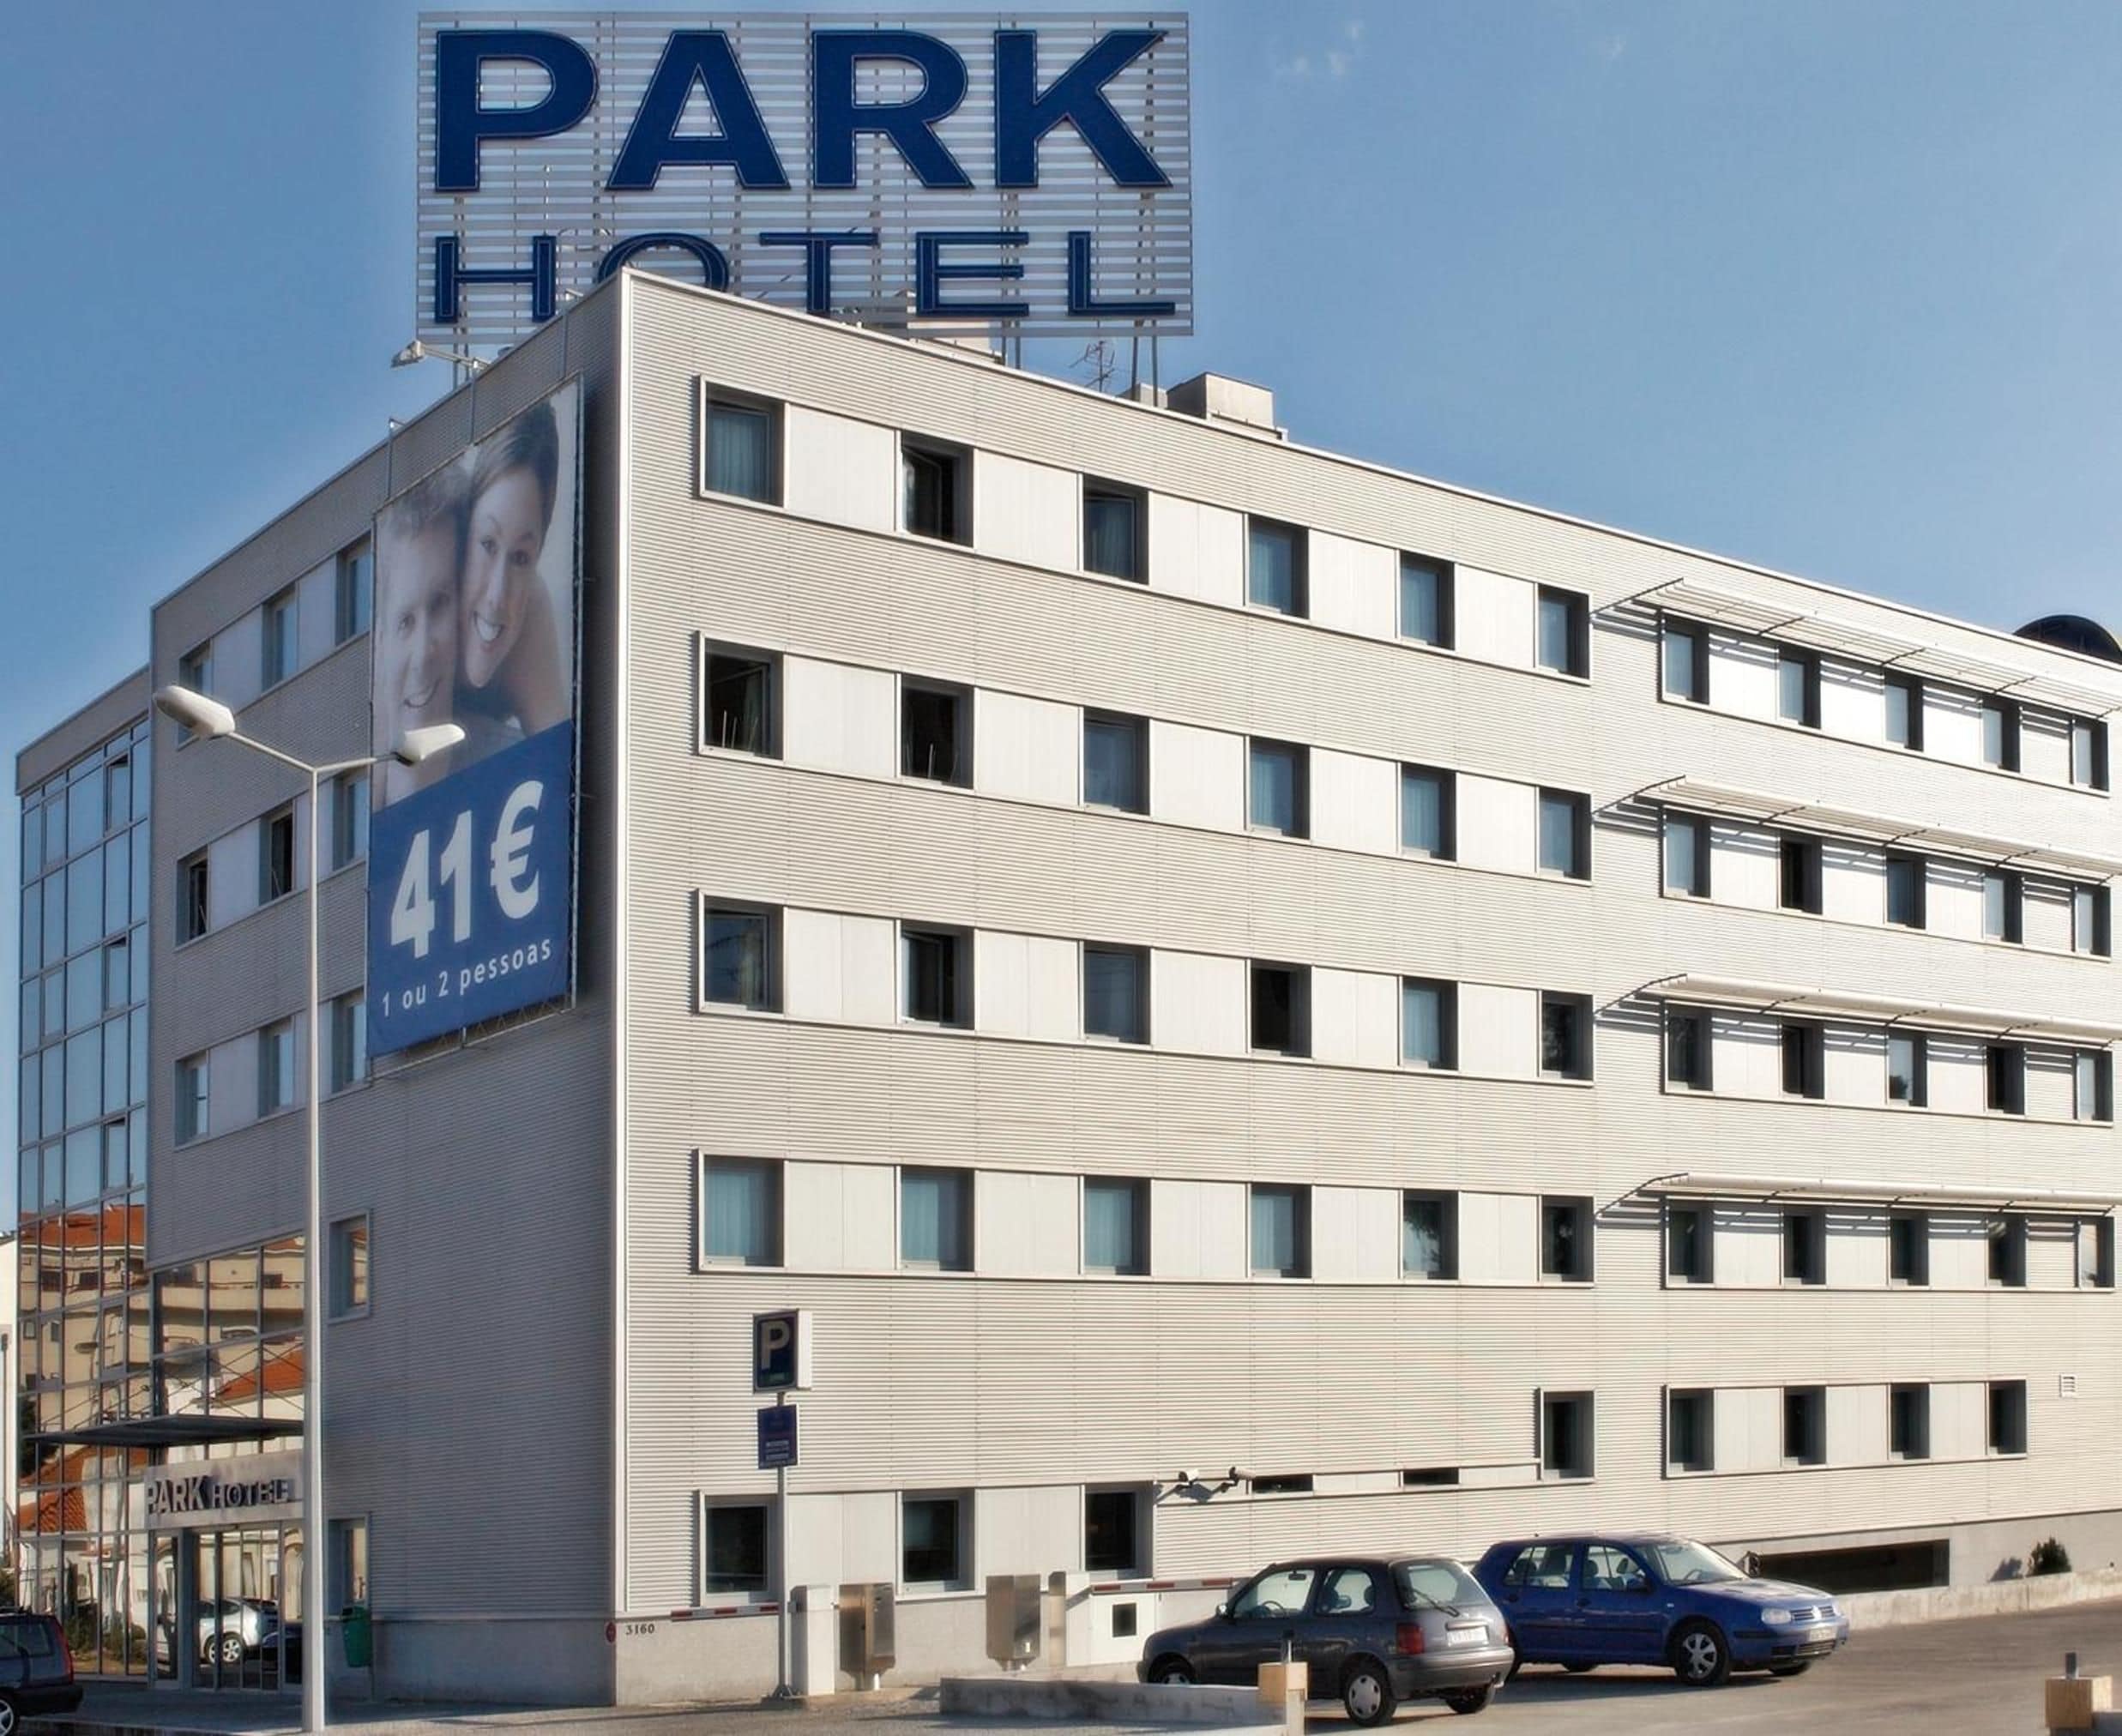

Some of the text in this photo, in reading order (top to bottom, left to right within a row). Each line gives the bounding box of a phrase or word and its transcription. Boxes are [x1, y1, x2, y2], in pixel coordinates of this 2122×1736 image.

[435, 29, 1173, 191] PARK
[435, 232, 1176, 323] HOTEL
[390, 781, 544, 959] 41 €
[382, 938, 552, 1017] 1 ou 2 pessoas
[761, 1319, 790, 1371] P
[147, 1476, 290, 1514] PARK HOTEL
[625, 1623, 655, 1636] 3160
